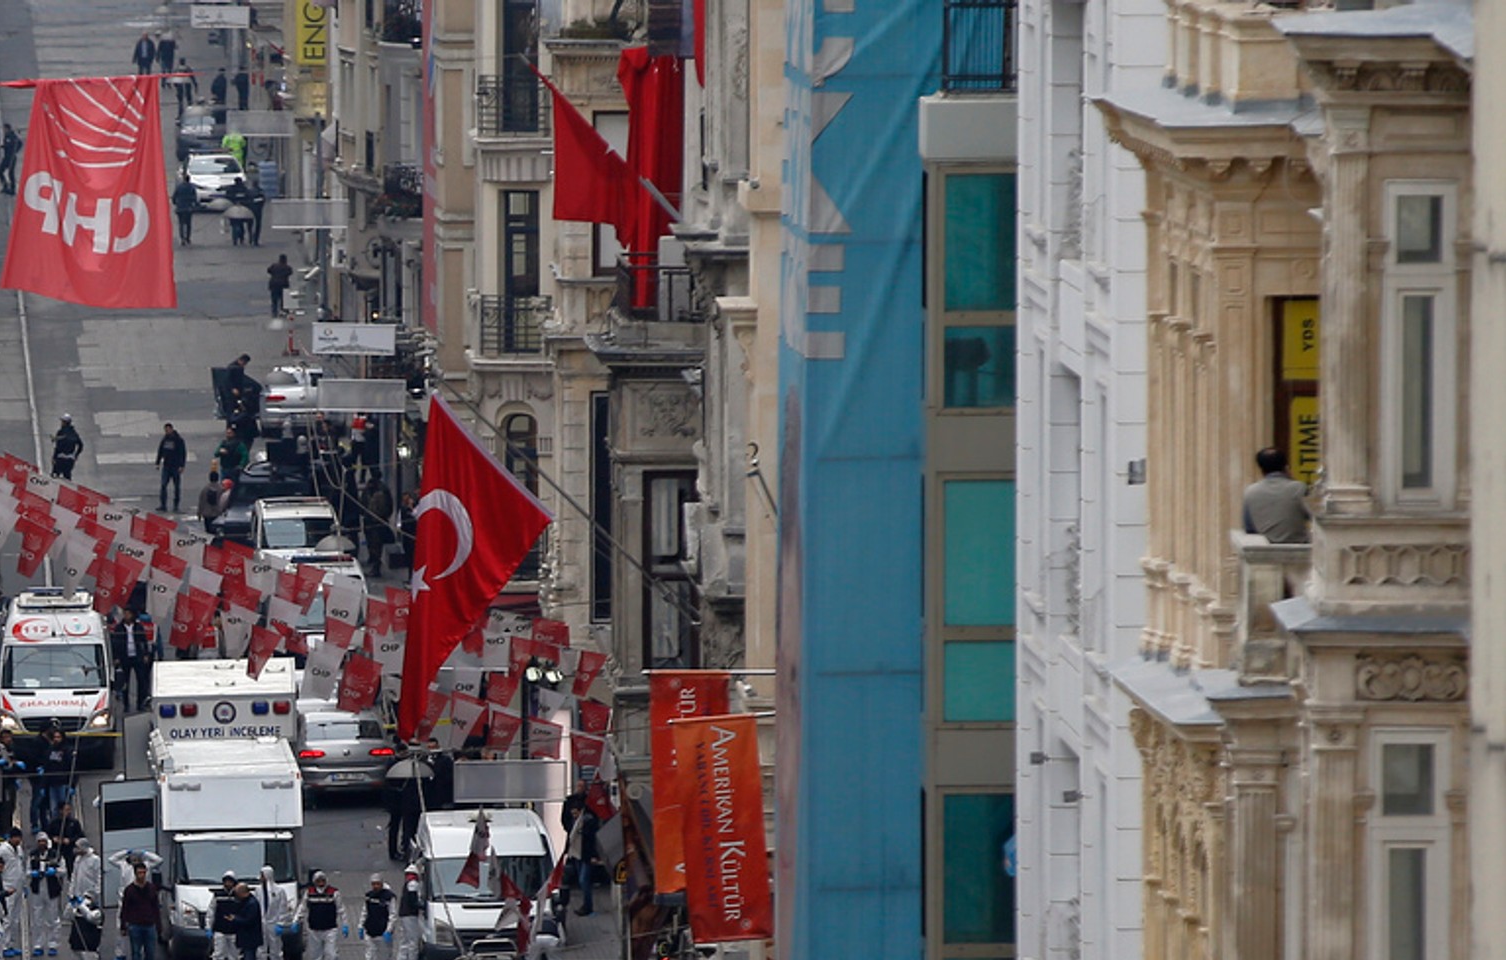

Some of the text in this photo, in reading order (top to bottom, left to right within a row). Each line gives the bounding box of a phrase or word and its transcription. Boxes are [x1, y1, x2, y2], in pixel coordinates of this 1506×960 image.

[1302, 318, 1316, 352] YDS
[170, 728, 199, 739] OLAY
[710, 725, 746, 921] AMERİKAN KÜLTÜR
